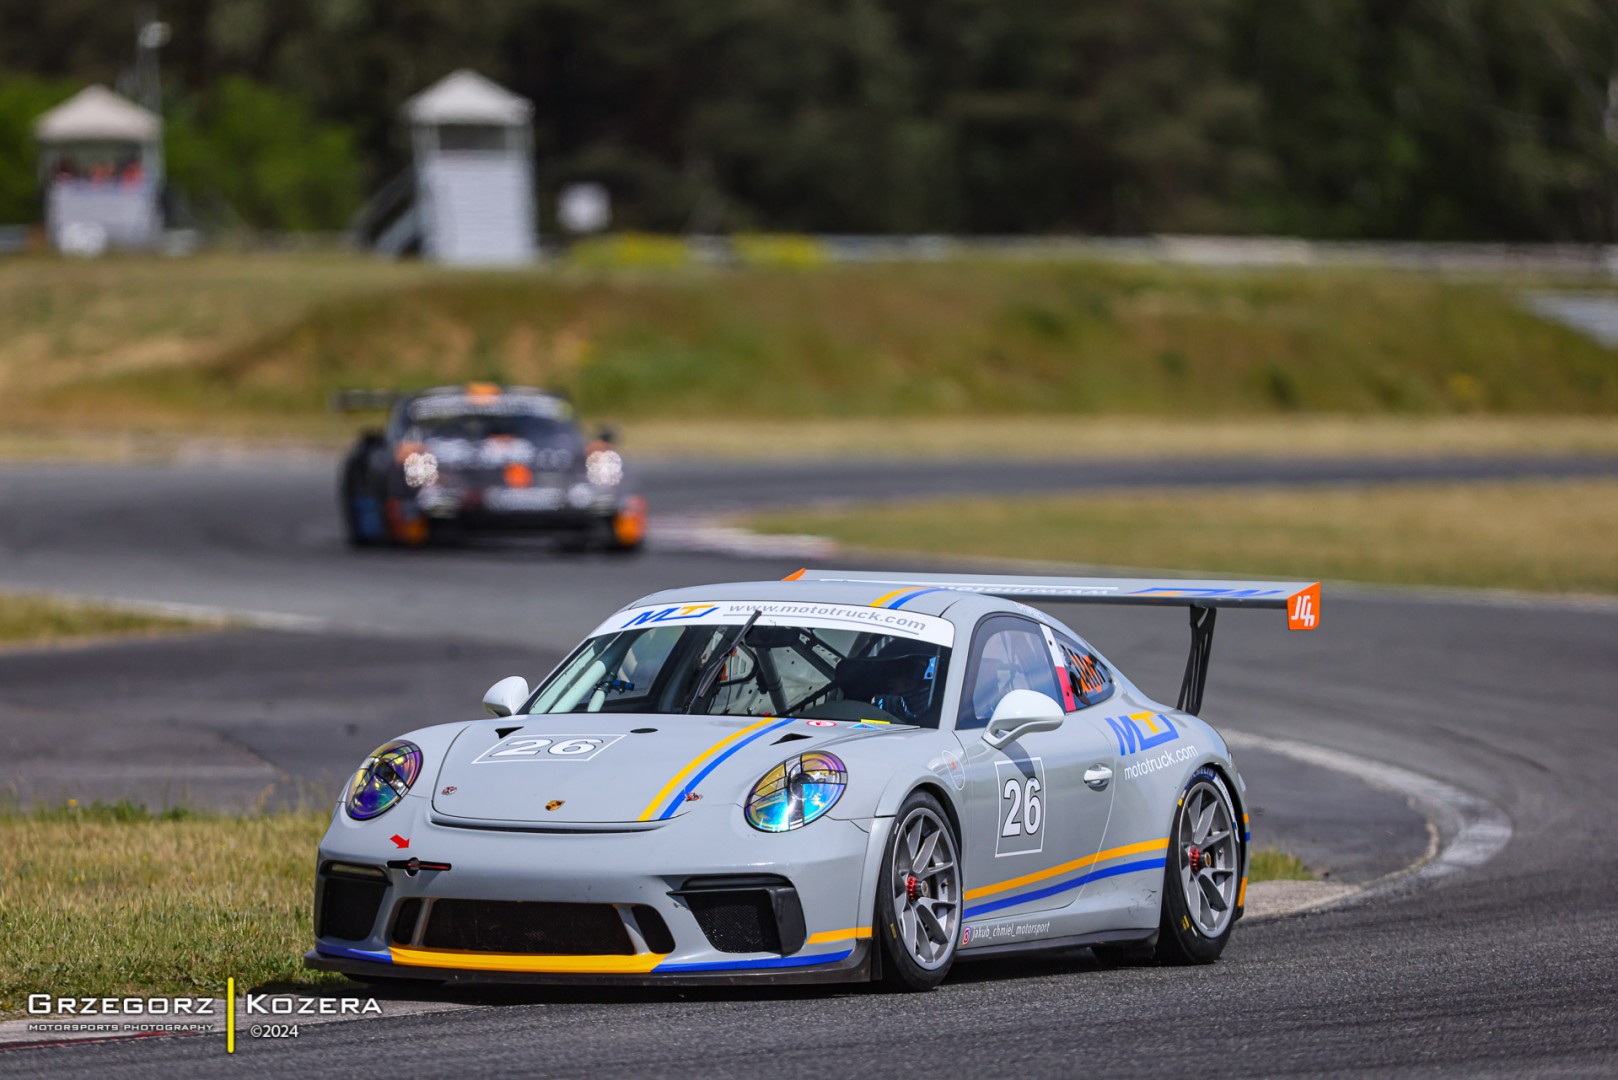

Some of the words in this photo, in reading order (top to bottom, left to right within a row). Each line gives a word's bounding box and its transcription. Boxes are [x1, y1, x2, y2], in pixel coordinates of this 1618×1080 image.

[729, 603, 926, 631] www.mototruck.com
[489, 738, 604, 757] 26
[1124, 745, 1199, 780] mototruck.com
[1001, 776, 1042, 838] 26
